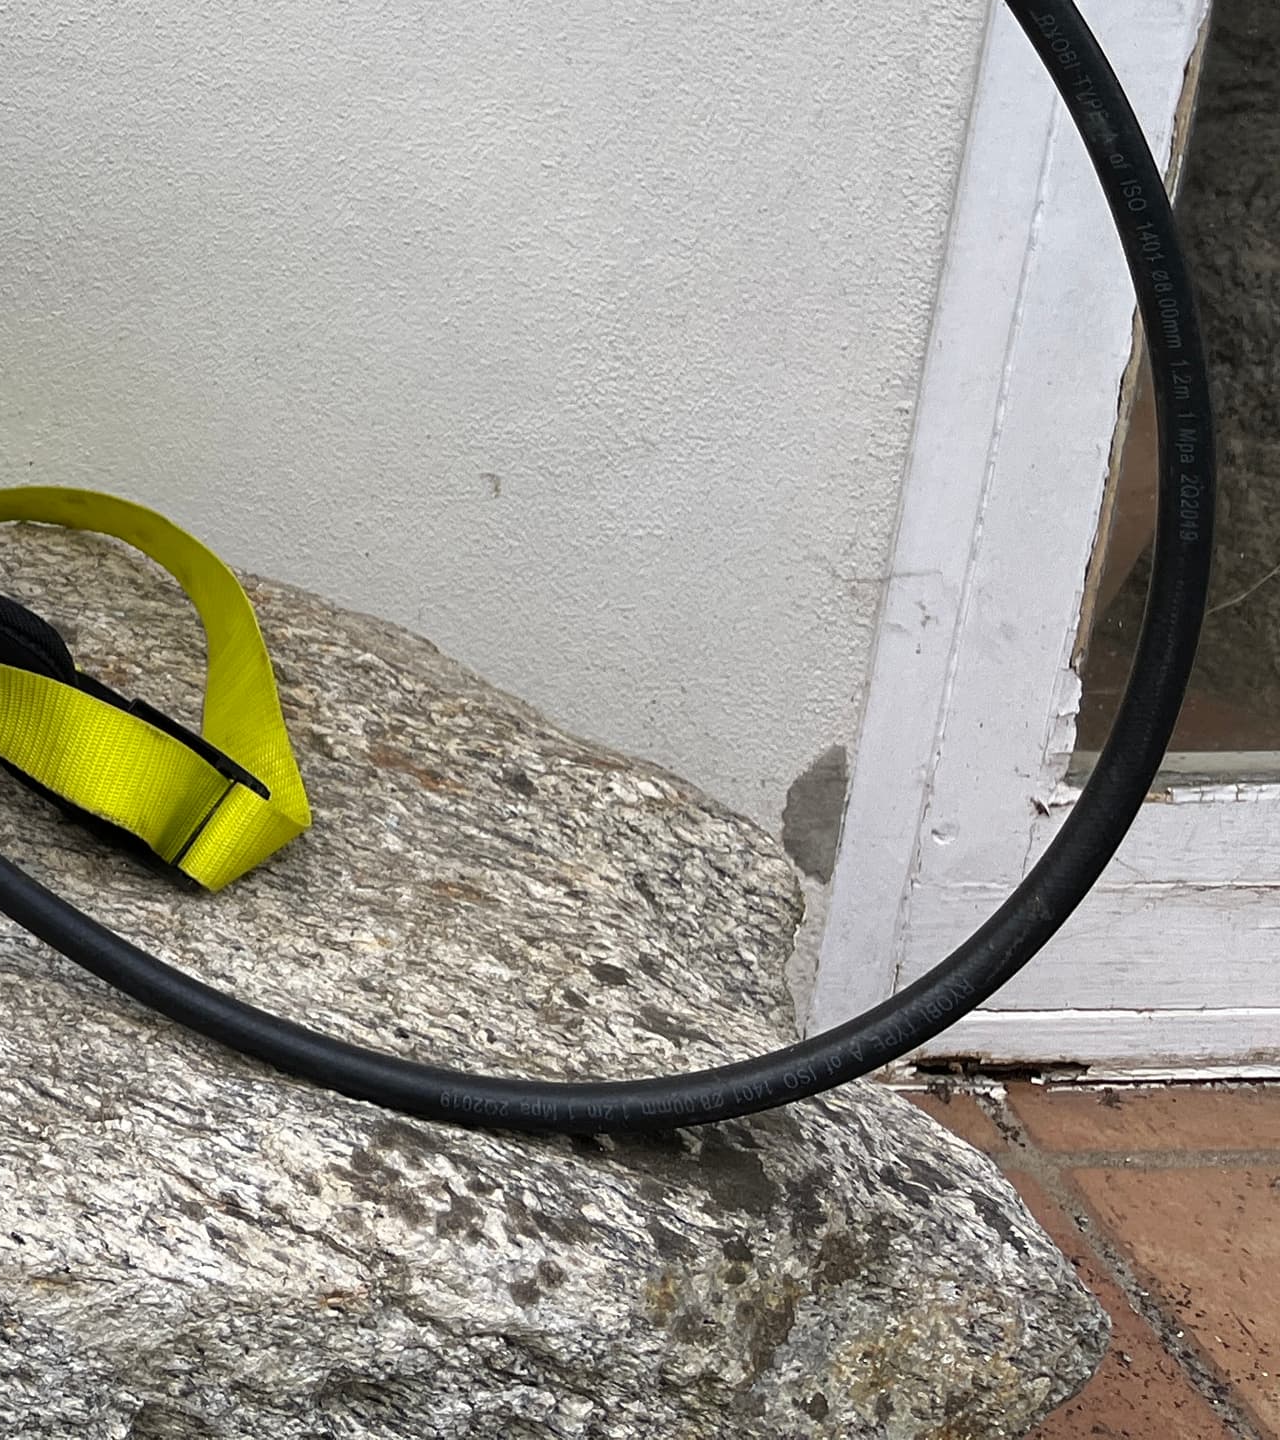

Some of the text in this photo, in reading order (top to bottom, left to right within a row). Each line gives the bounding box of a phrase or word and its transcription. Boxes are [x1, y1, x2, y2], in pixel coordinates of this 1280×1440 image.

[1035, 13, 1082, 71] RYOBI
[1072, 74, 1111, 125] TYPE
[1108, 153, 1133, 171] of
[1119, 179, 1148, 213] ISO
[1135, 221, 1165, 262] 1401
[1169, 360, 1192, 401] 1.2m
[1176, 410, 1198, 419] 1
[1175, 428, 1198, 464] Mpa
[1179, 472, 1201, 542] 2Q2019
[920, 976, 975, 1025] RYOBI
[872, 1016, 917, 1051] TYPE
[824, 1054, 841, 1075] of
[848, 1042, 865, 1063] A
[733, 1079, 773, 1104] 1401
[782, 1065, 817, 1090] ISO
[520, 1100, 558, 1121] Mpa
[586, 1101, 630, 1121] 1.2m
